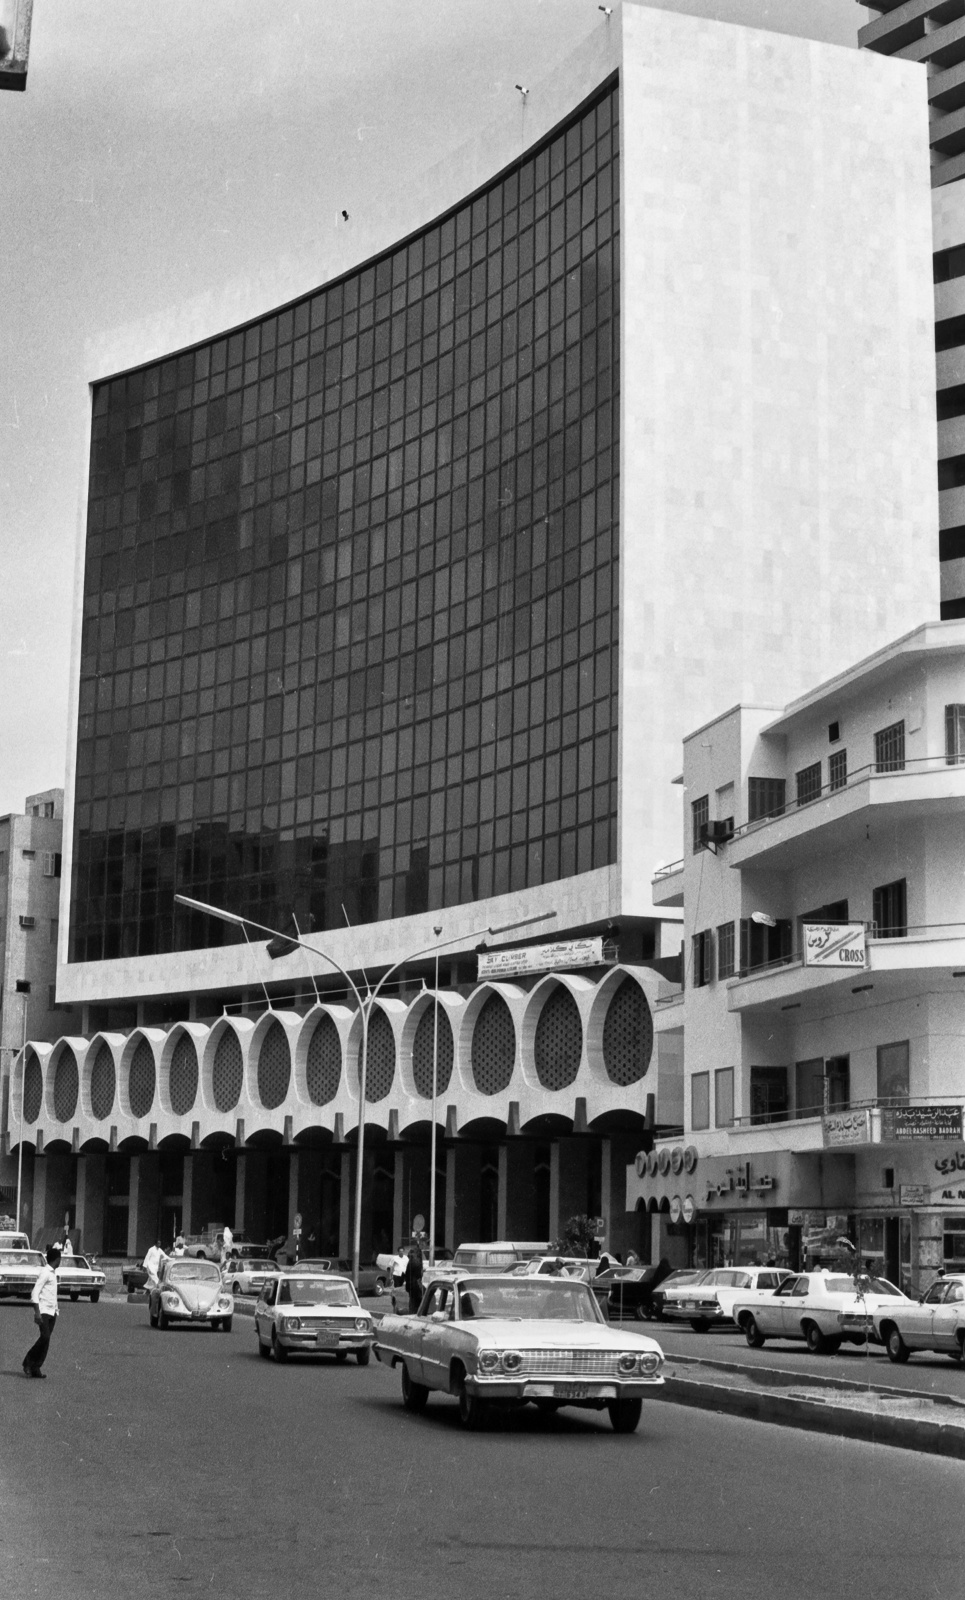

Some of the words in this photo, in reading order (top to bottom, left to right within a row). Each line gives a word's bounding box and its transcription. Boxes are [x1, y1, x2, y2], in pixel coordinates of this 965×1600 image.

[839, 949, 864, 962] CROSS
[938, 1126, 961, 1135] BADRAH
[941, 1190, 956, 1199] AL
[596, 1218, 604, 1233] P
